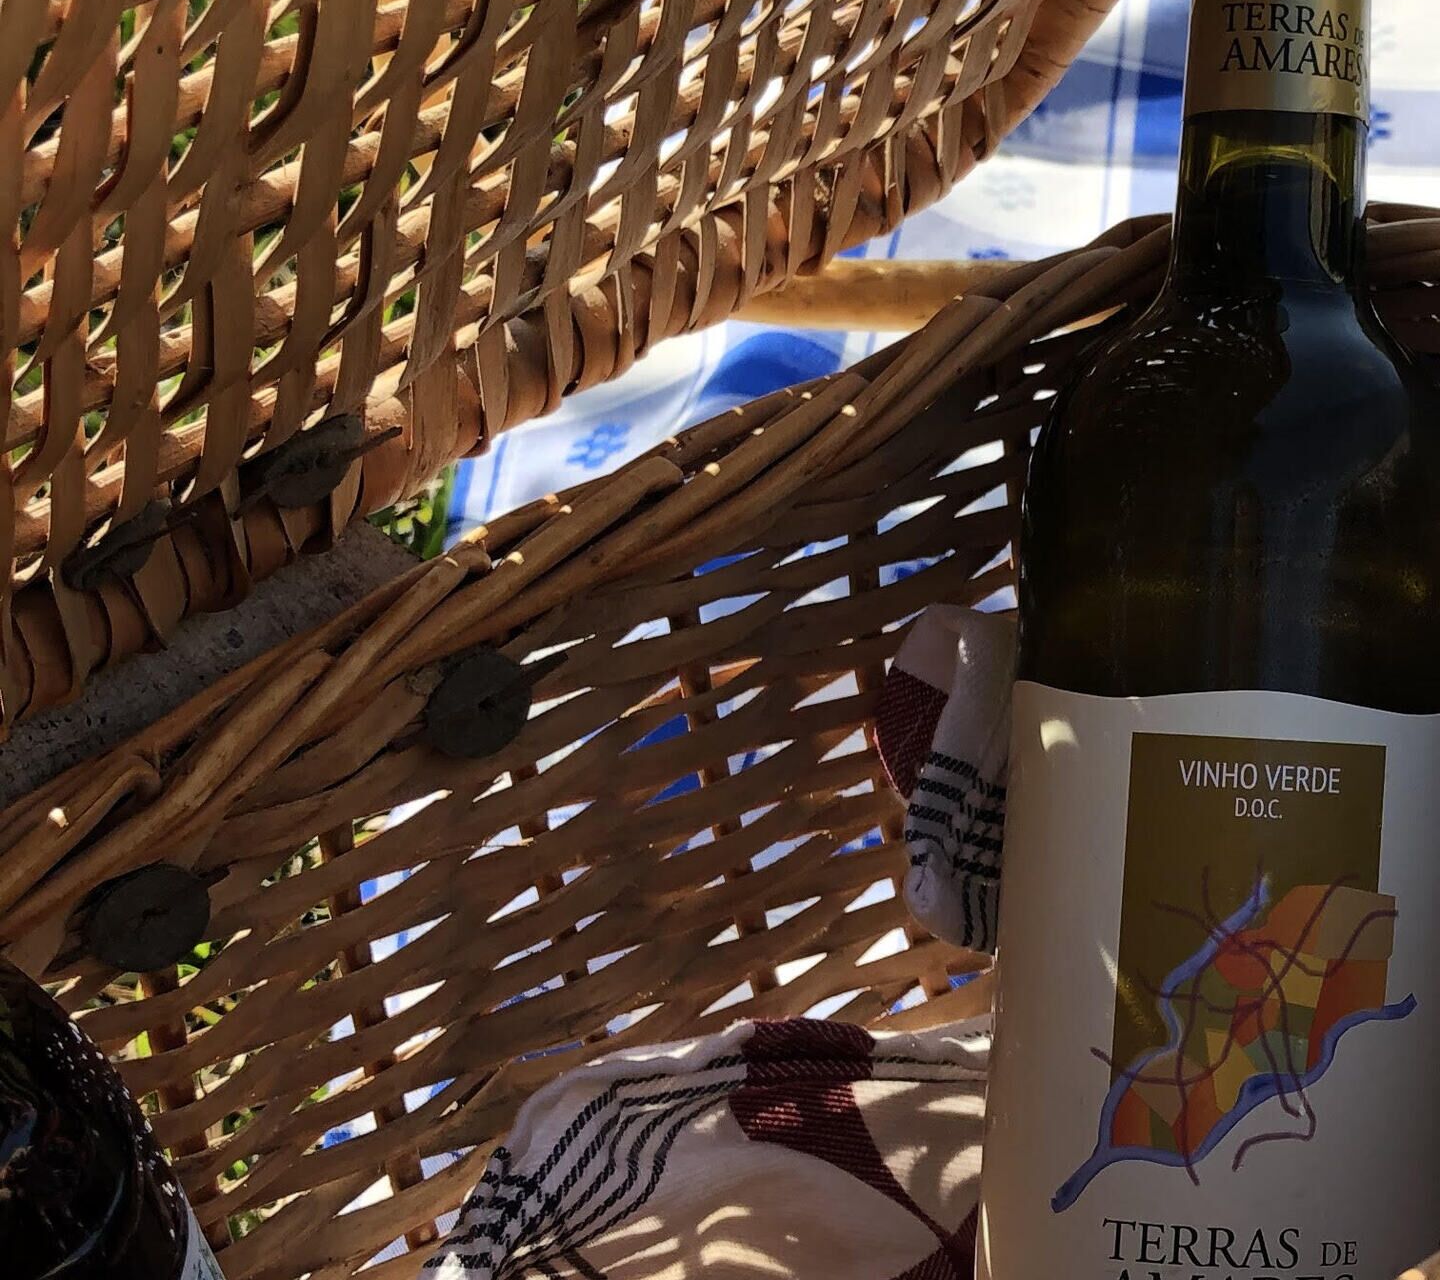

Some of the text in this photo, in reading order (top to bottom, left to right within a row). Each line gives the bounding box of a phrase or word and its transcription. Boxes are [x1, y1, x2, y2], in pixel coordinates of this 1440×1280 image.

[1222, 2, 1349, 42] TERRAS
[1219, 36, 1363, 87] AMARES
[1178, 758, 1342, 795] VINHO VERDE
[1234, 796, 1284, 820] D.O.C.
[1102, 1217, 1359, 1270] TERRAS DE
